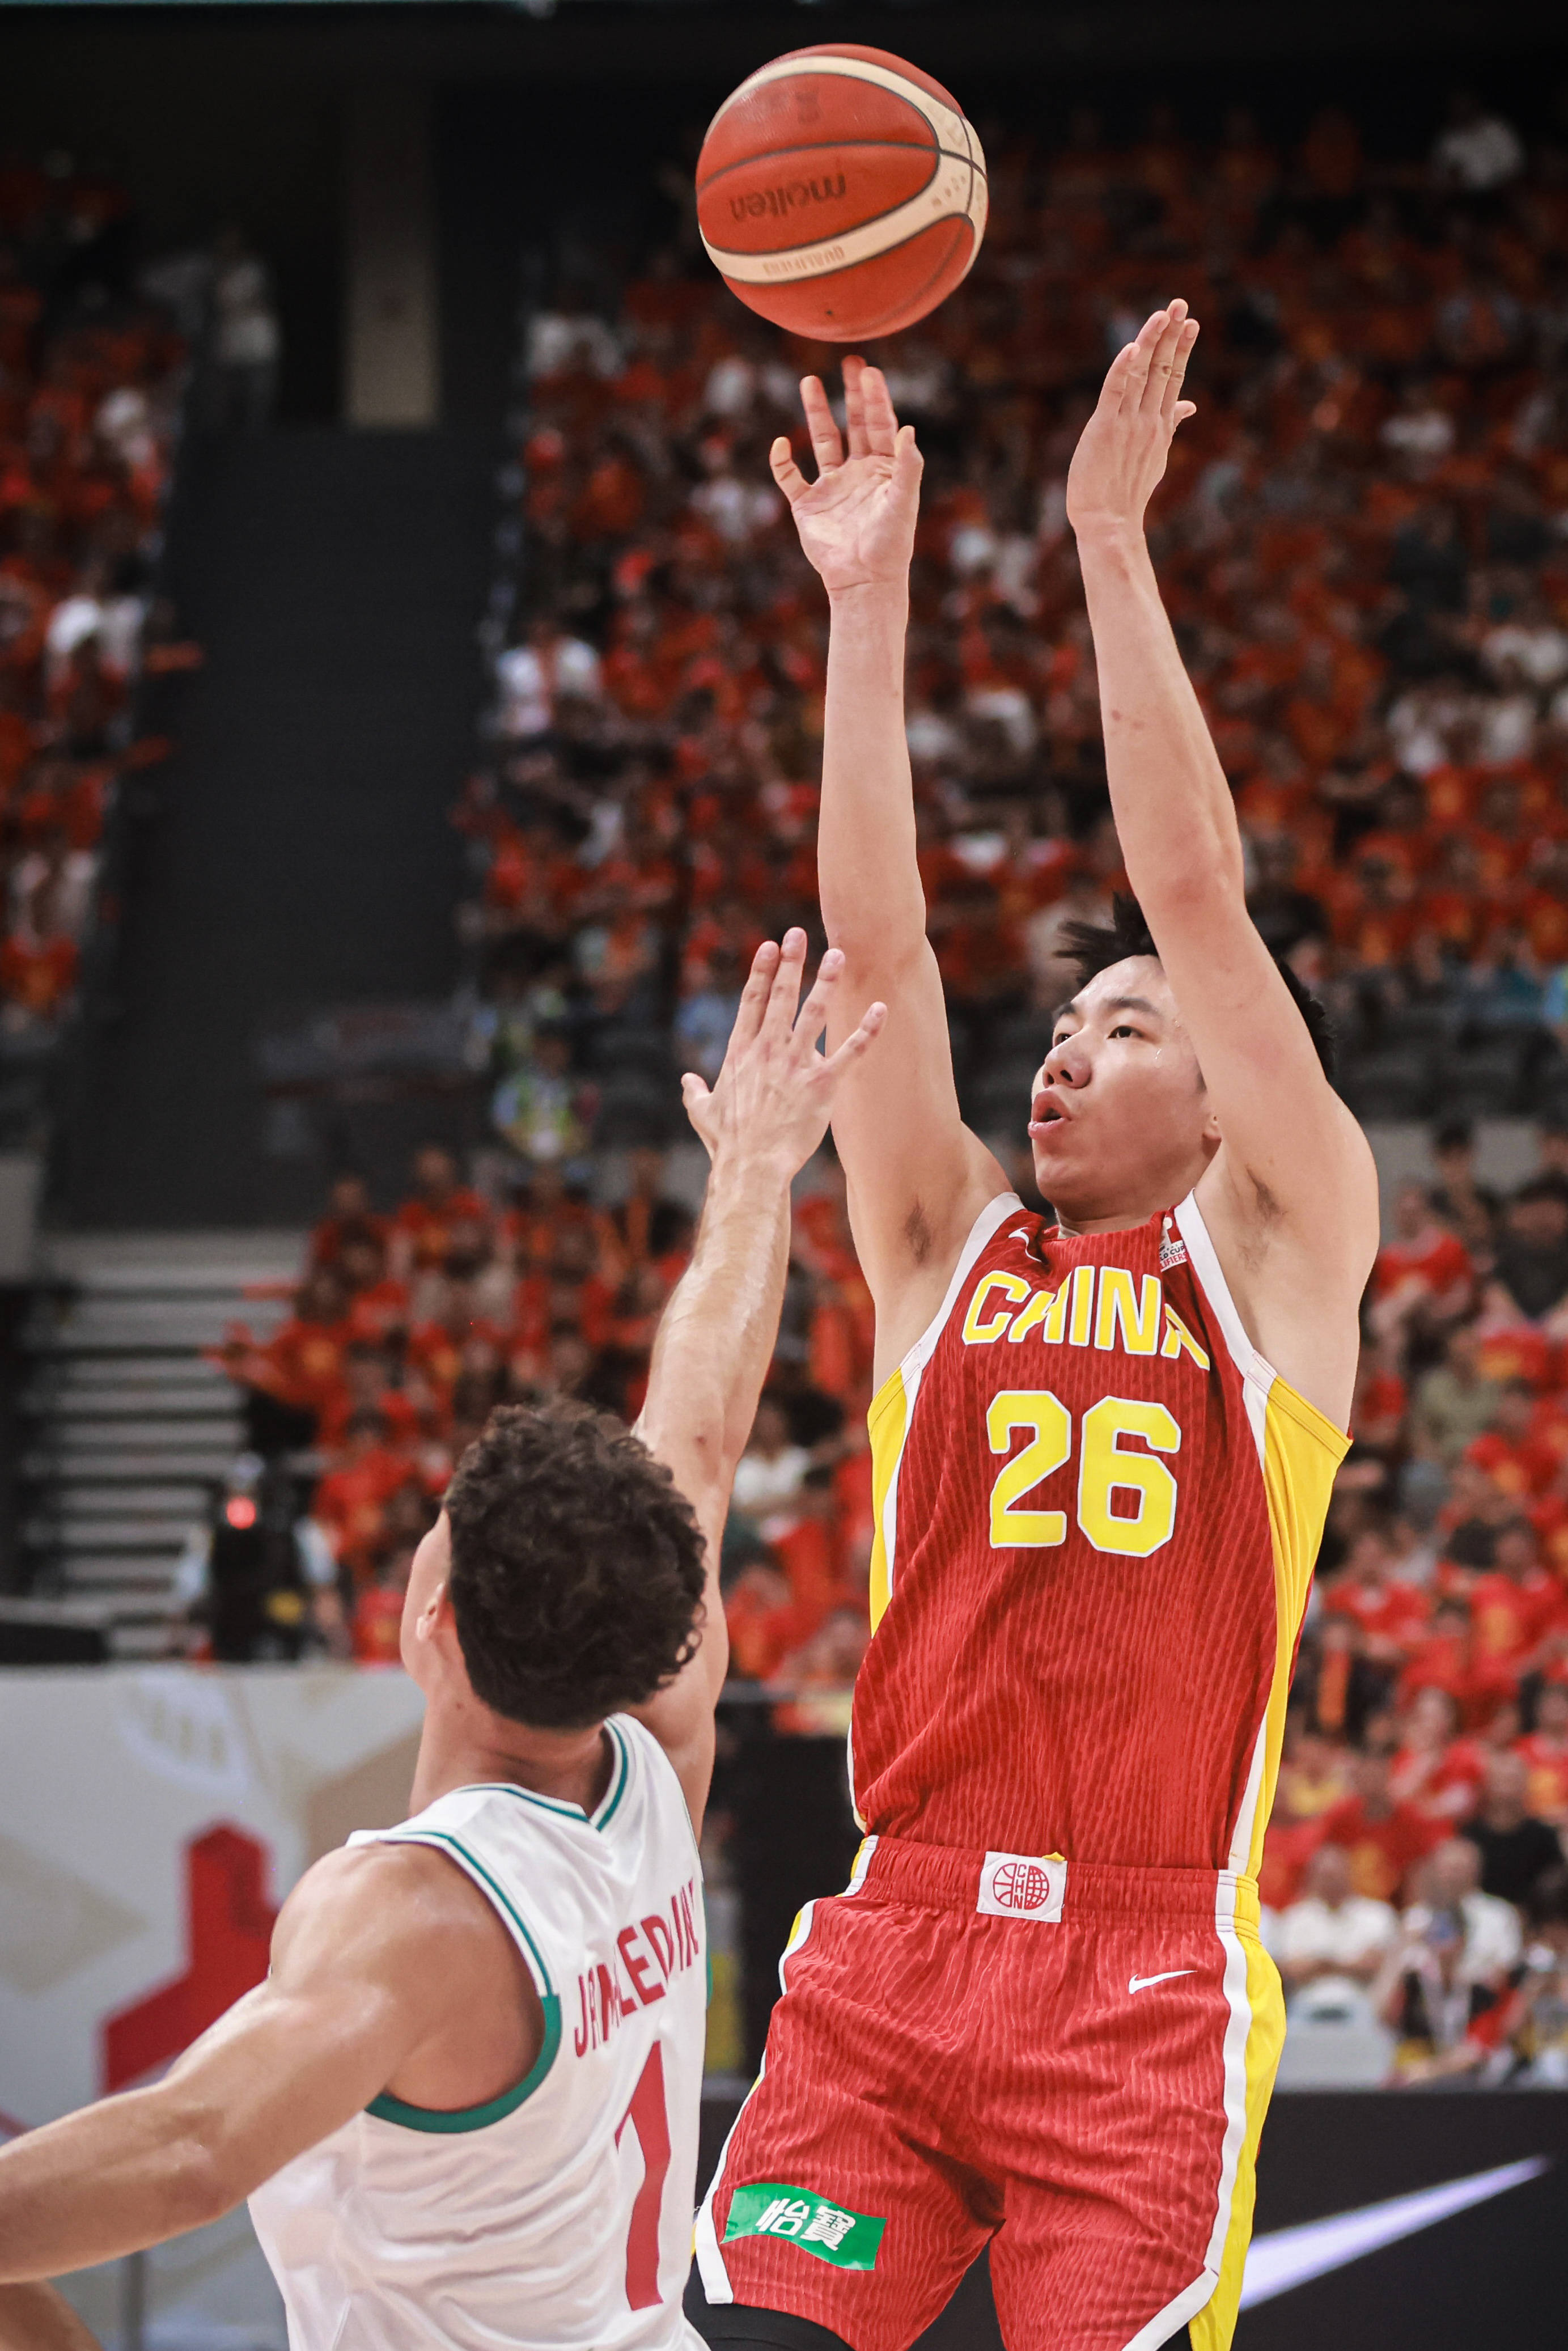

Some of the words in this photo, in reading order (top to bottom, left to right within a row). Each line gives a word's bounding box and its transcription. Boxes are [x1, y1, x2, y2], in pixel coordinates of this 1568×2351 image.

[729, 173, 846, 223] molten
[961, 1265, 1210, 1371] CHINA
[986, 1390, 1181, 1558] 26
[614, 2040, 672, 2311] 1
